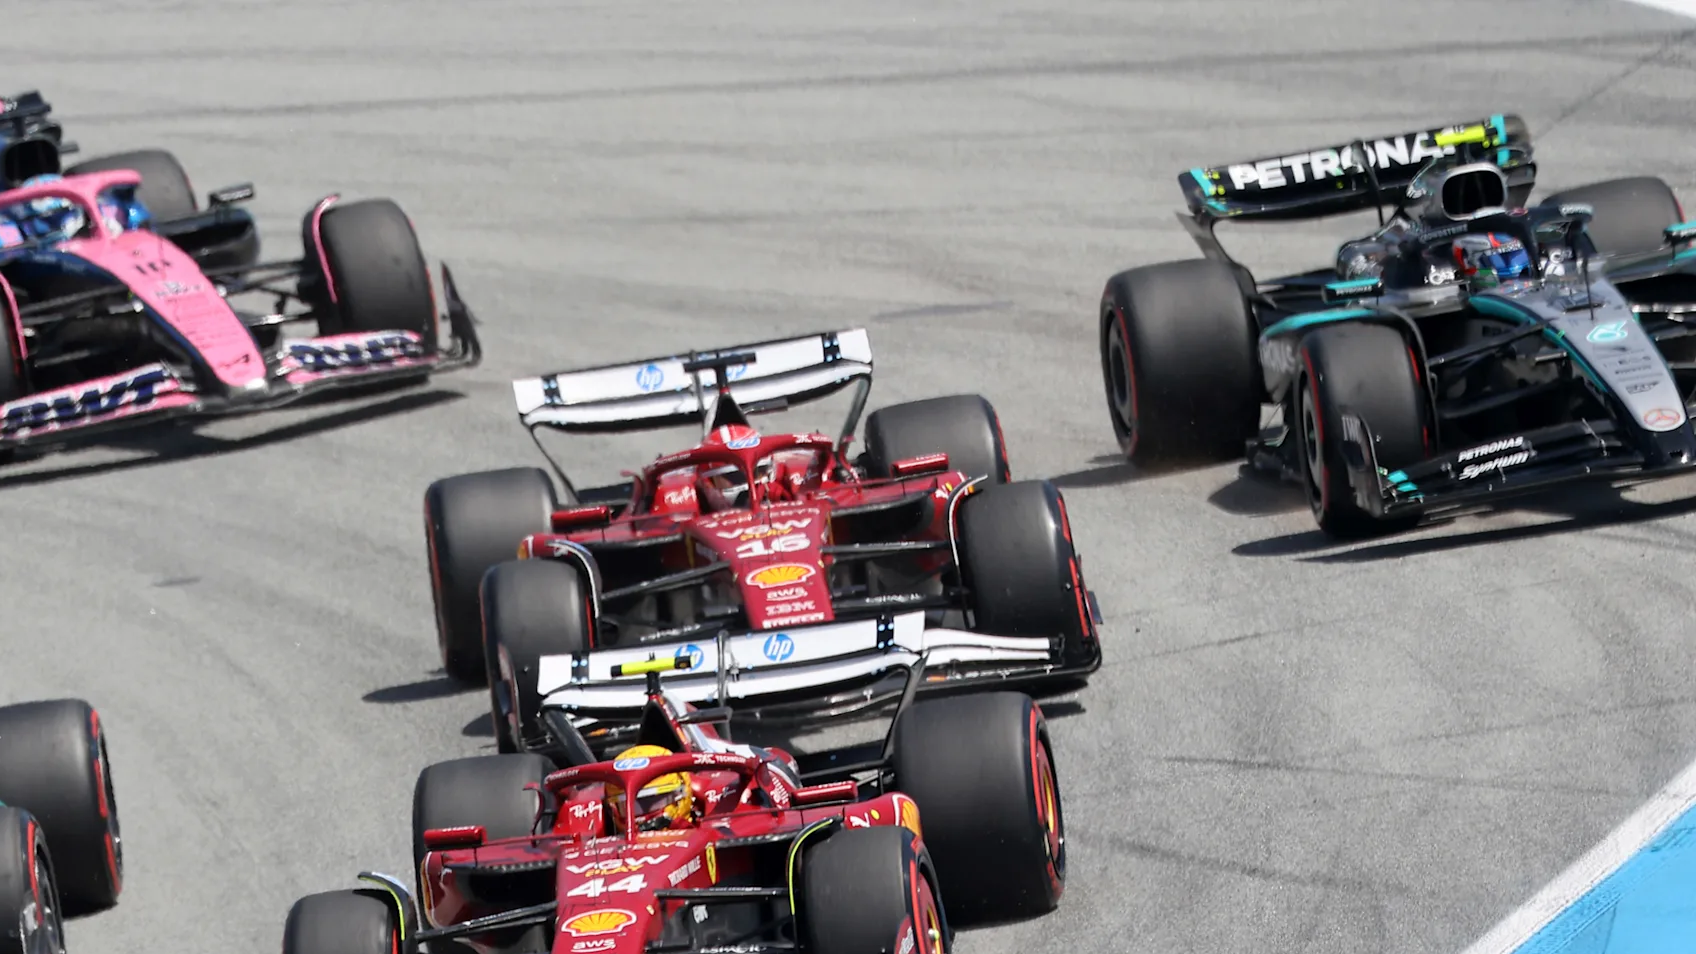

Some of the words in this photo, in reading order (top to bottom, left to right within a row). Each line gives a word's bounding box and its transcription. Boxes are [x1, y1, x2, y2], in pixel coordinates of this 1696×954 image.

[639, 365, 662, 391] hp
[1457, 436, 1525, 463] PETRONAS
[736, 533, 811, 559] 16
[764, 632, 794, 662] hp
[566, 873, 648, 898] 44
[571, 938, 617, 952] aws
